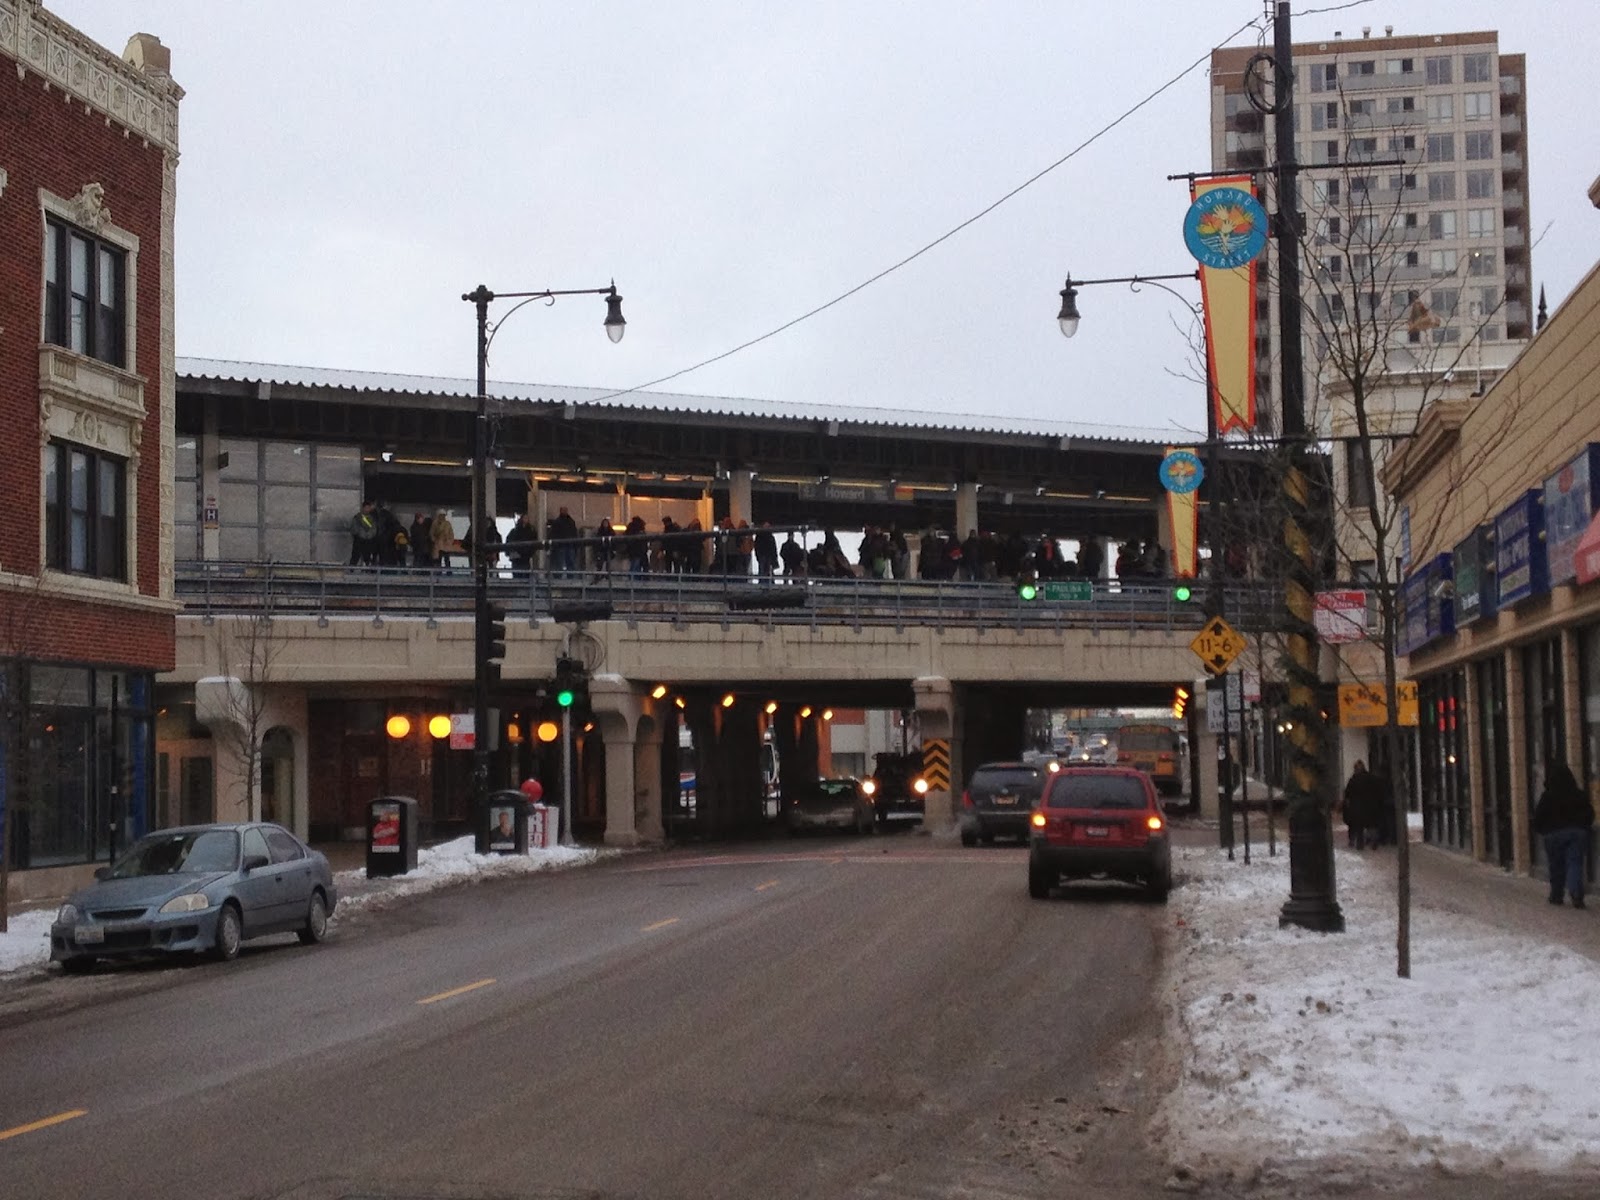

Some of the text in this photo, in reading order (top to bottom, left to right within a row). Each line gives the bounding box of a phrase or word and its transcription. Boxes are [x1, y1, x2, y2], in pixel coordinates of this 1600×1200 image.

[1196, 191, 1252, 210] HOWARD
[1202, 250, 1251, 266] STREET
[825, 487, 866, 500] Howard
[207, 509, 216, 520] H
